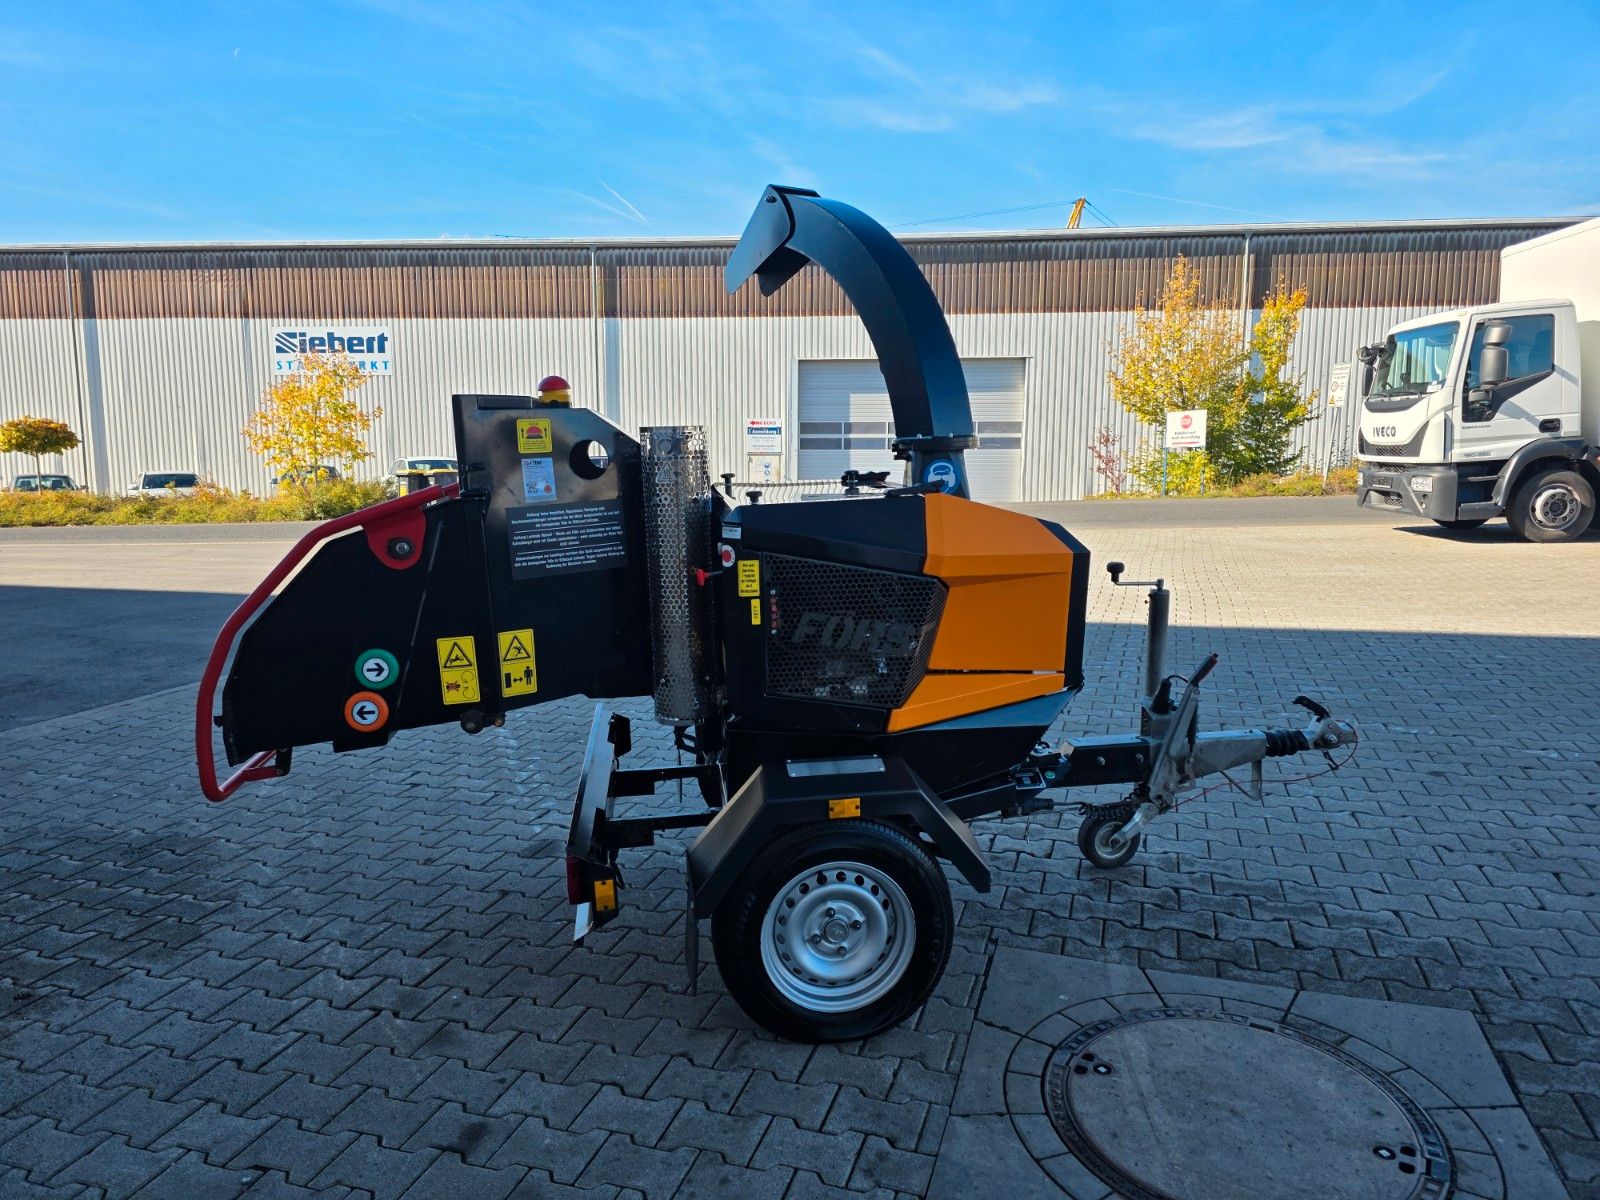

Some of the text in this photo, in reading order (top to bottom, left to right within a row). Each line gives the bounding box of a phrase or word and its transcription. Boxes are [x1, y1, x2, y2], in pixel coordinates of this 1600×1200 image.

[275, 332, 389, 354] Siebert
[277, 360, 390, 371] STARKT
[1372, 426, 1397, 438] IVECO
